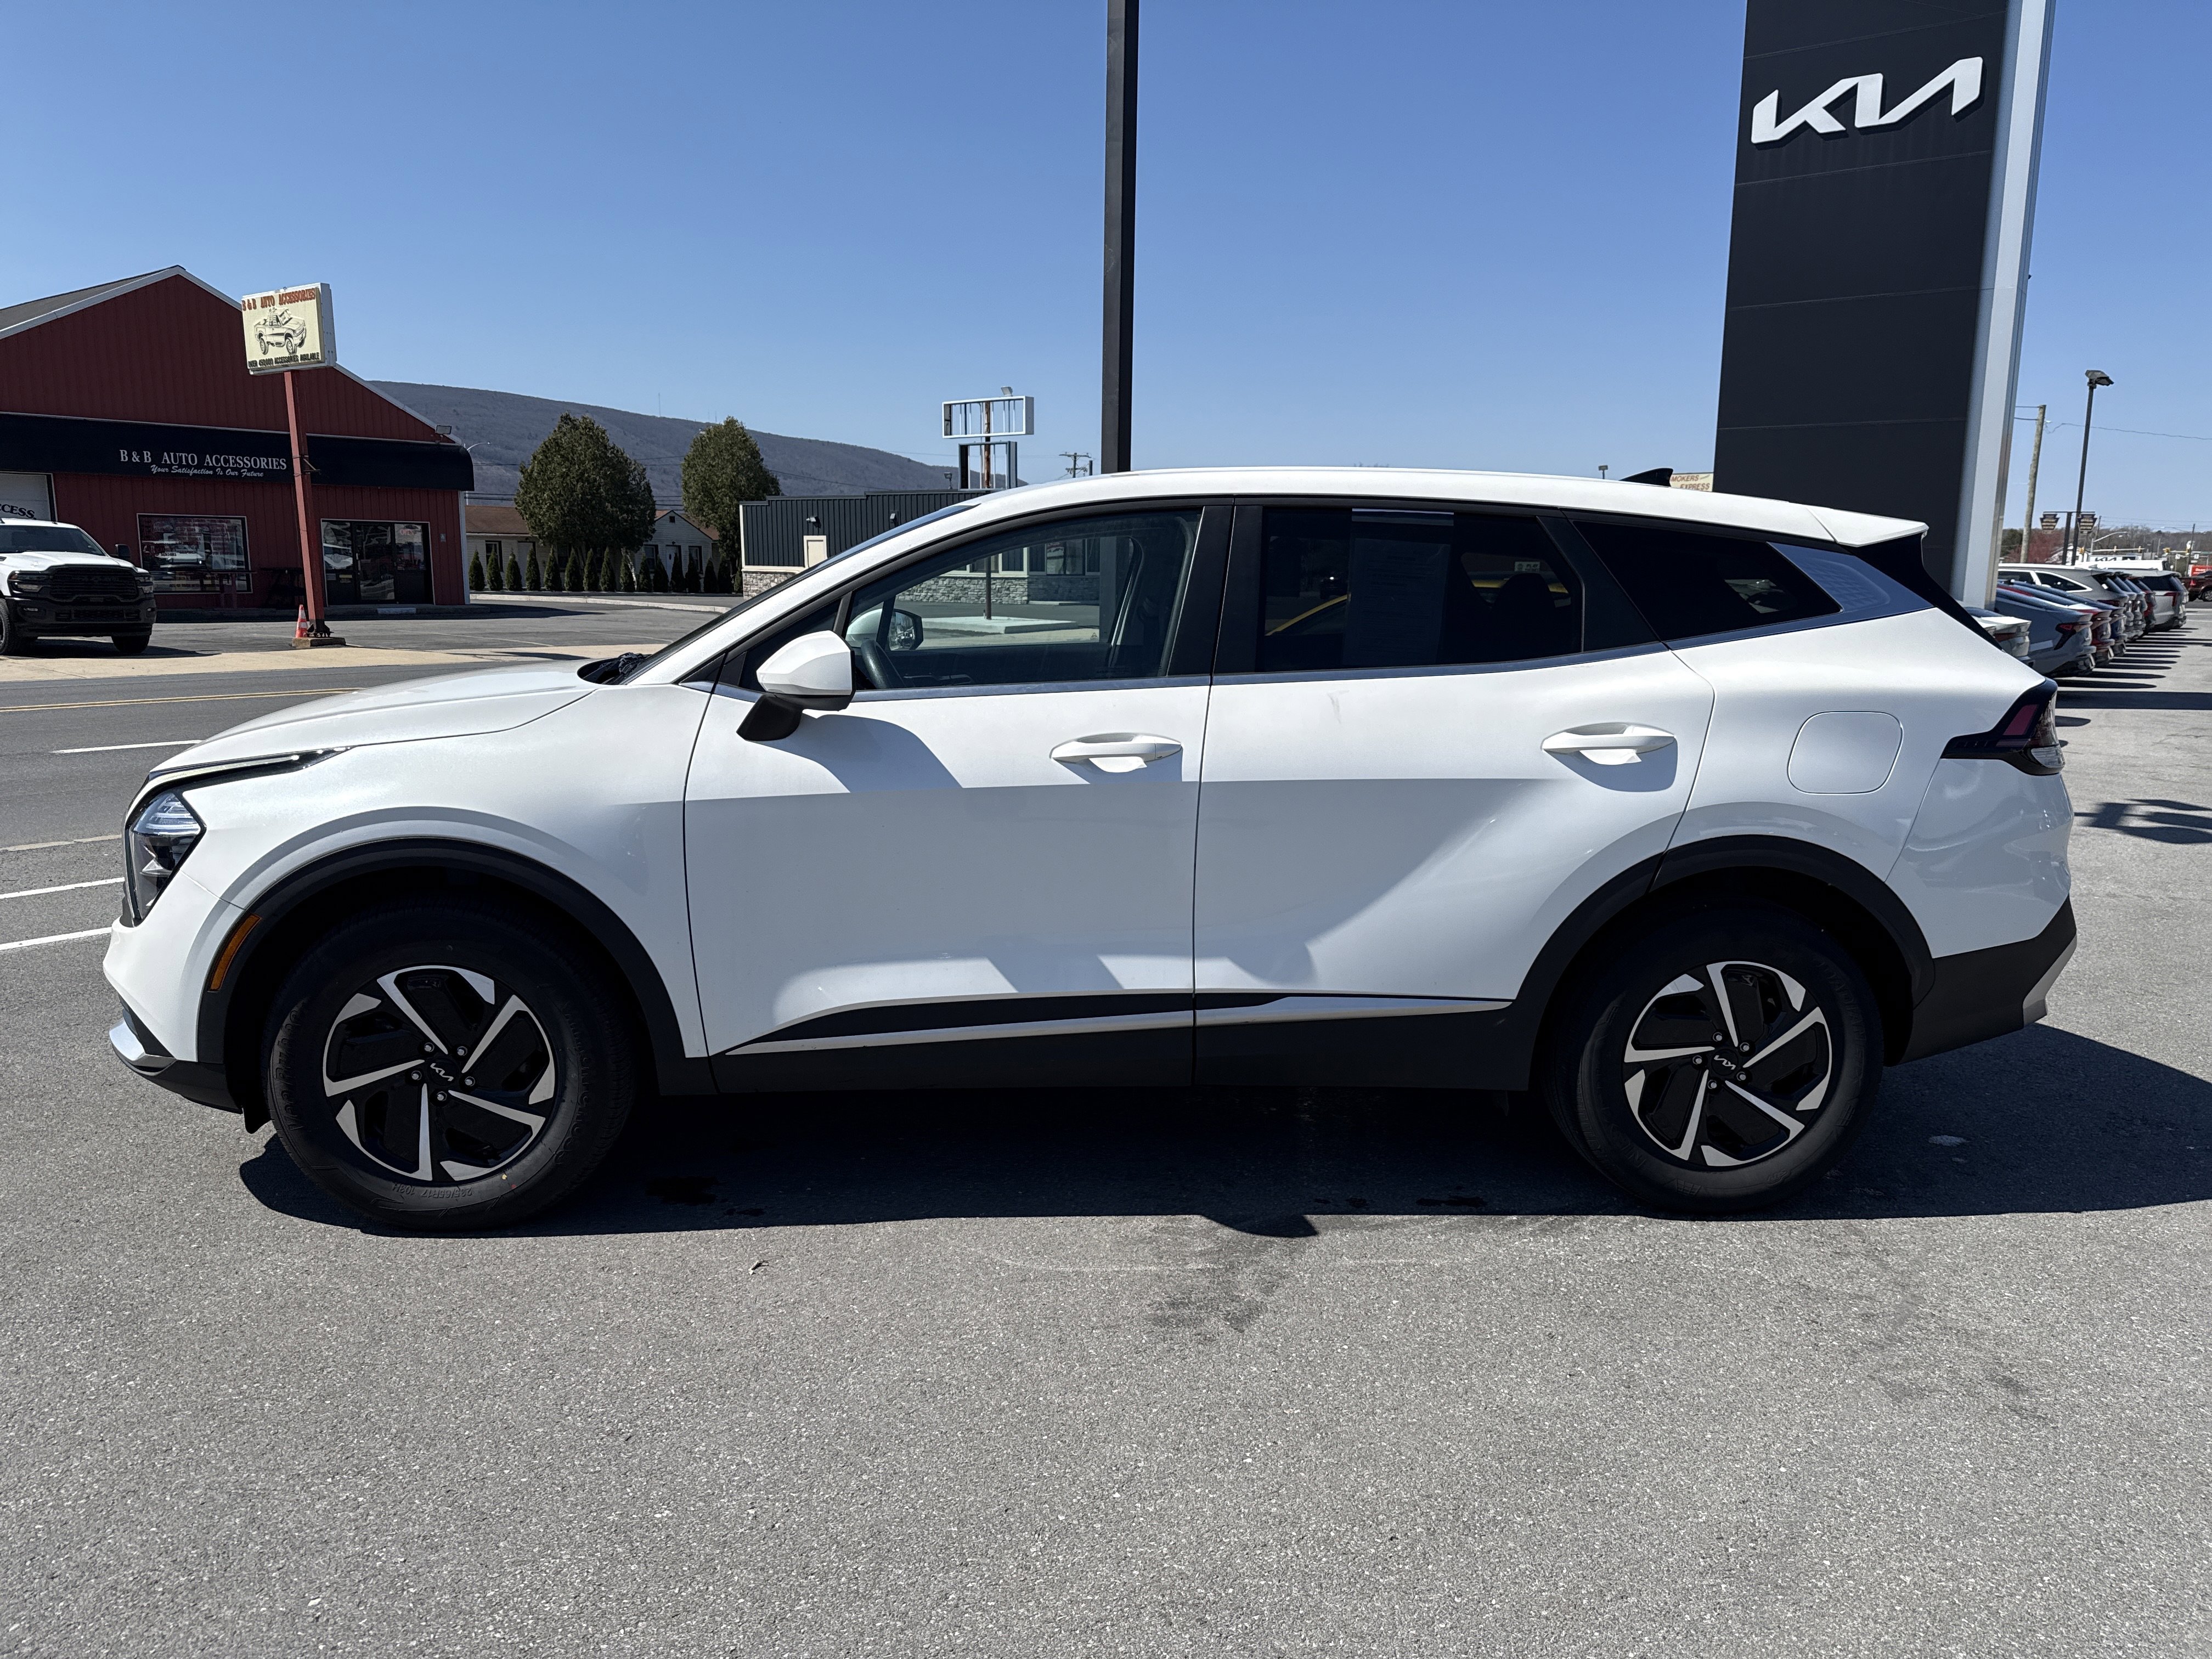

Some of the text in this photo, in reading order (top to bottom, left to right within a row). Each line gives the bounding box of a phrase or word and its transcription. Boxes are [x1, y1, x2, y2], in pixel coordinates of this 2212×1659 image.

[1751, 57, 1983, 144] KIA
[261, 295, 275, 308] AUTO
[279, 288, 315, 305] ACCESSORIES
[150, 464, 170, 474] Your
[171, 465, 213, 476] Satisfaction
[240, 469, 264, 477] Future
[161, 452, 198, 466] AUTO
[204, 454, 287, 470] ACCESSORIES
